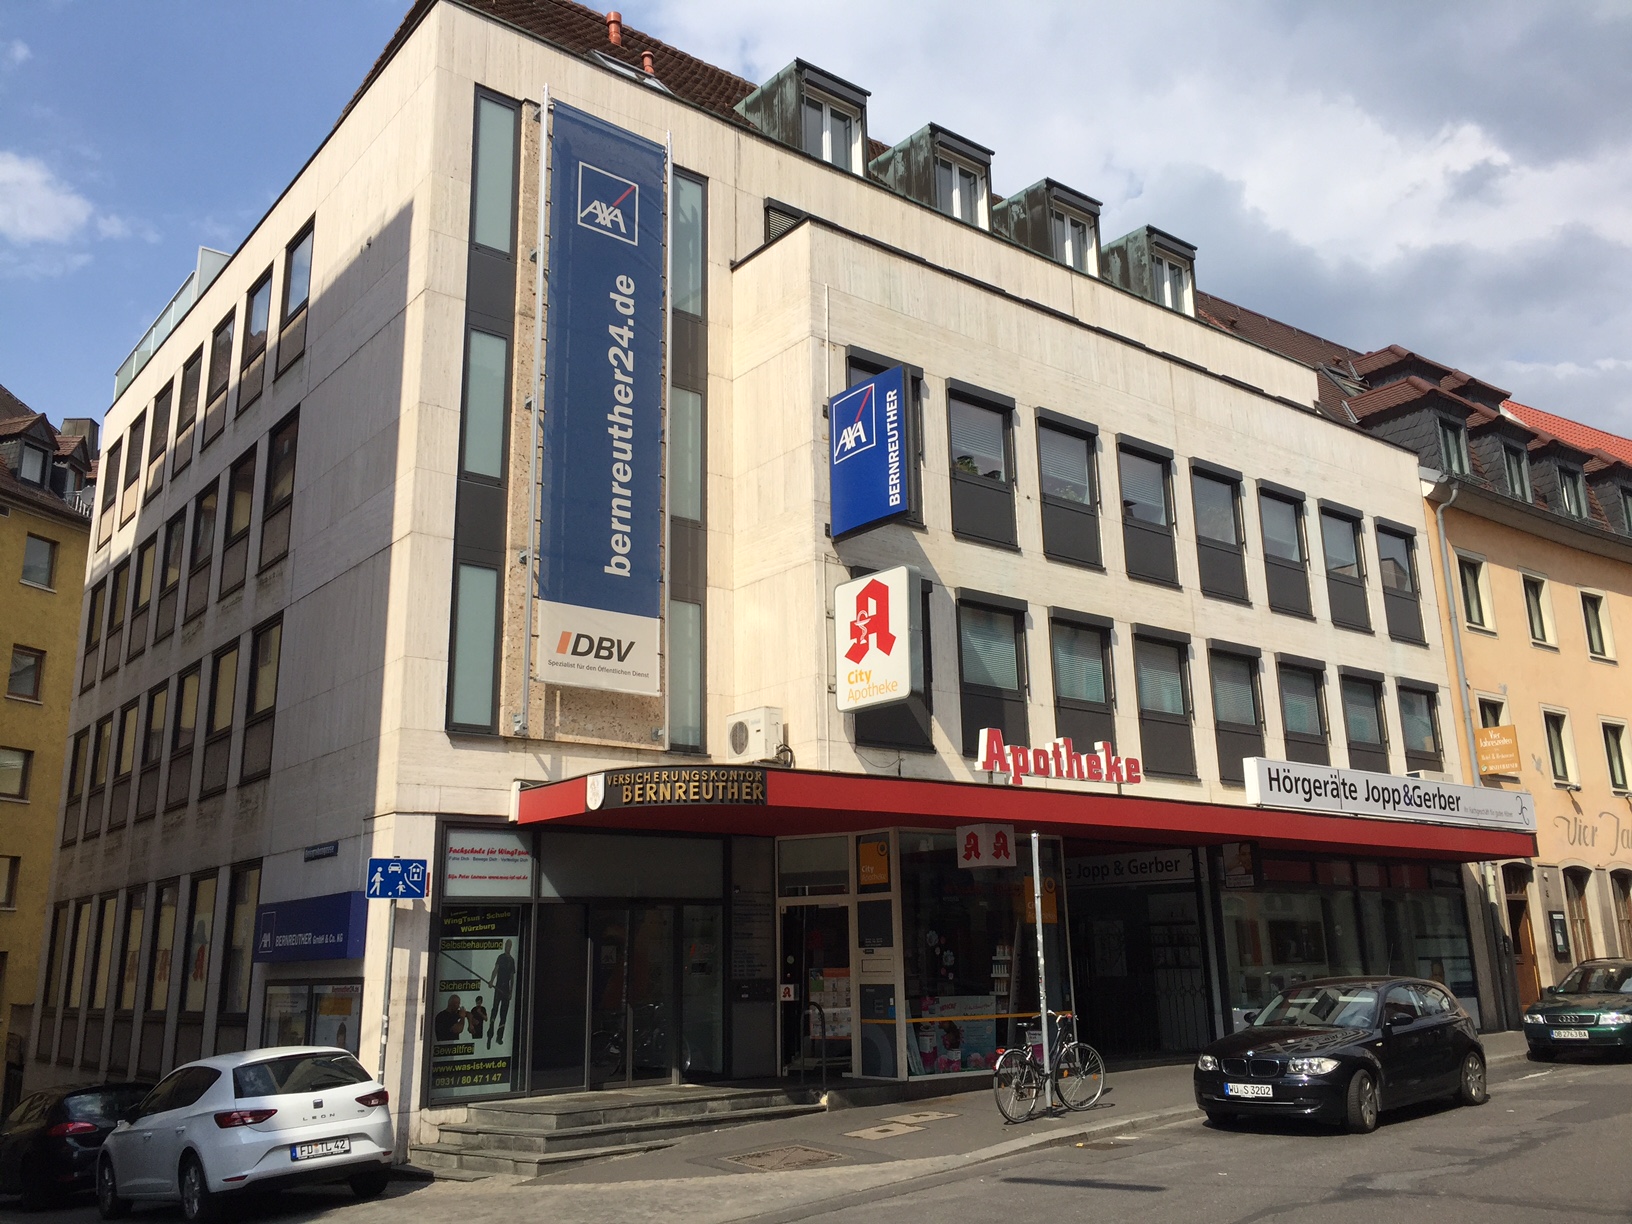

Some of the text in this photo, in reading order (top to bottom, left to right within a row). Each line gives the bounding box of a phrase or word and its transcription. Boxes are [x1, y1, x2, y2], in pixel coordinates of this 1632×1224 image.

[580, 200, 627, 233] AXA
[604, 274, 636, 577] bernreuther24.de
[835, 420, 867, 457] AXA
[886, 389, 900, 507] BERNREUTHER
[570, 633, 636, 662] DBV
[548, 660, 576, 669] Spezialist
[597, 665, 632, 676] Öffentlichen
[632, 670, 650, 678] Dienst
[847, 669, 872, 684] City
[847, 679, 898, 703] Apotheke
[975, 728, 1141, 785] Apotheke
[607, 770, 762, 786] VERSICHERUNGSKONTOR
[1267, 767, 1358, 803] Hörgeräte
[622, 782, 763, 803] BERNREUTHER
[1553, 811, 1632, 857] Vier Ja
[448, 847, 529, 856] Fachschule für WingTsun
[861, 865, 874, 874] City
[1077, 864, 1110, 882] Jopp
[1113, 860, 1124, 876] &
[1127, 857, 1181, 875] Gerber
[444, 915, 480, 925] WingTsun
[486, 911, 511, 920] Schule
[461, 923, 496, 933] Würzburg
[275, 933, 312, 947] BERNREUTHER
[441, 940, 503, 950] Selbstbehauptung
[440, 981, 481, 991] Sicherheit
[434, 1044, 475, 1055] Gewaltfrei
[433, 1060, 507, 1073] www.was-ist-wt.de
[435, 1078, 454, 1087] 0931
[461, 1076, 471, 1084] 80
[473, 1075, 484, 1083] 47
[492, 1073, 502, 1081] 47
[1229, 1085, 1271, 1096] WÜ S 3202
[302, 1113, 336, 1121] LEON
[300, 1144, 313, 1156] FD
[319, 1142, 332, 1152] TL
[334, 1139, 345, 1149] 42
